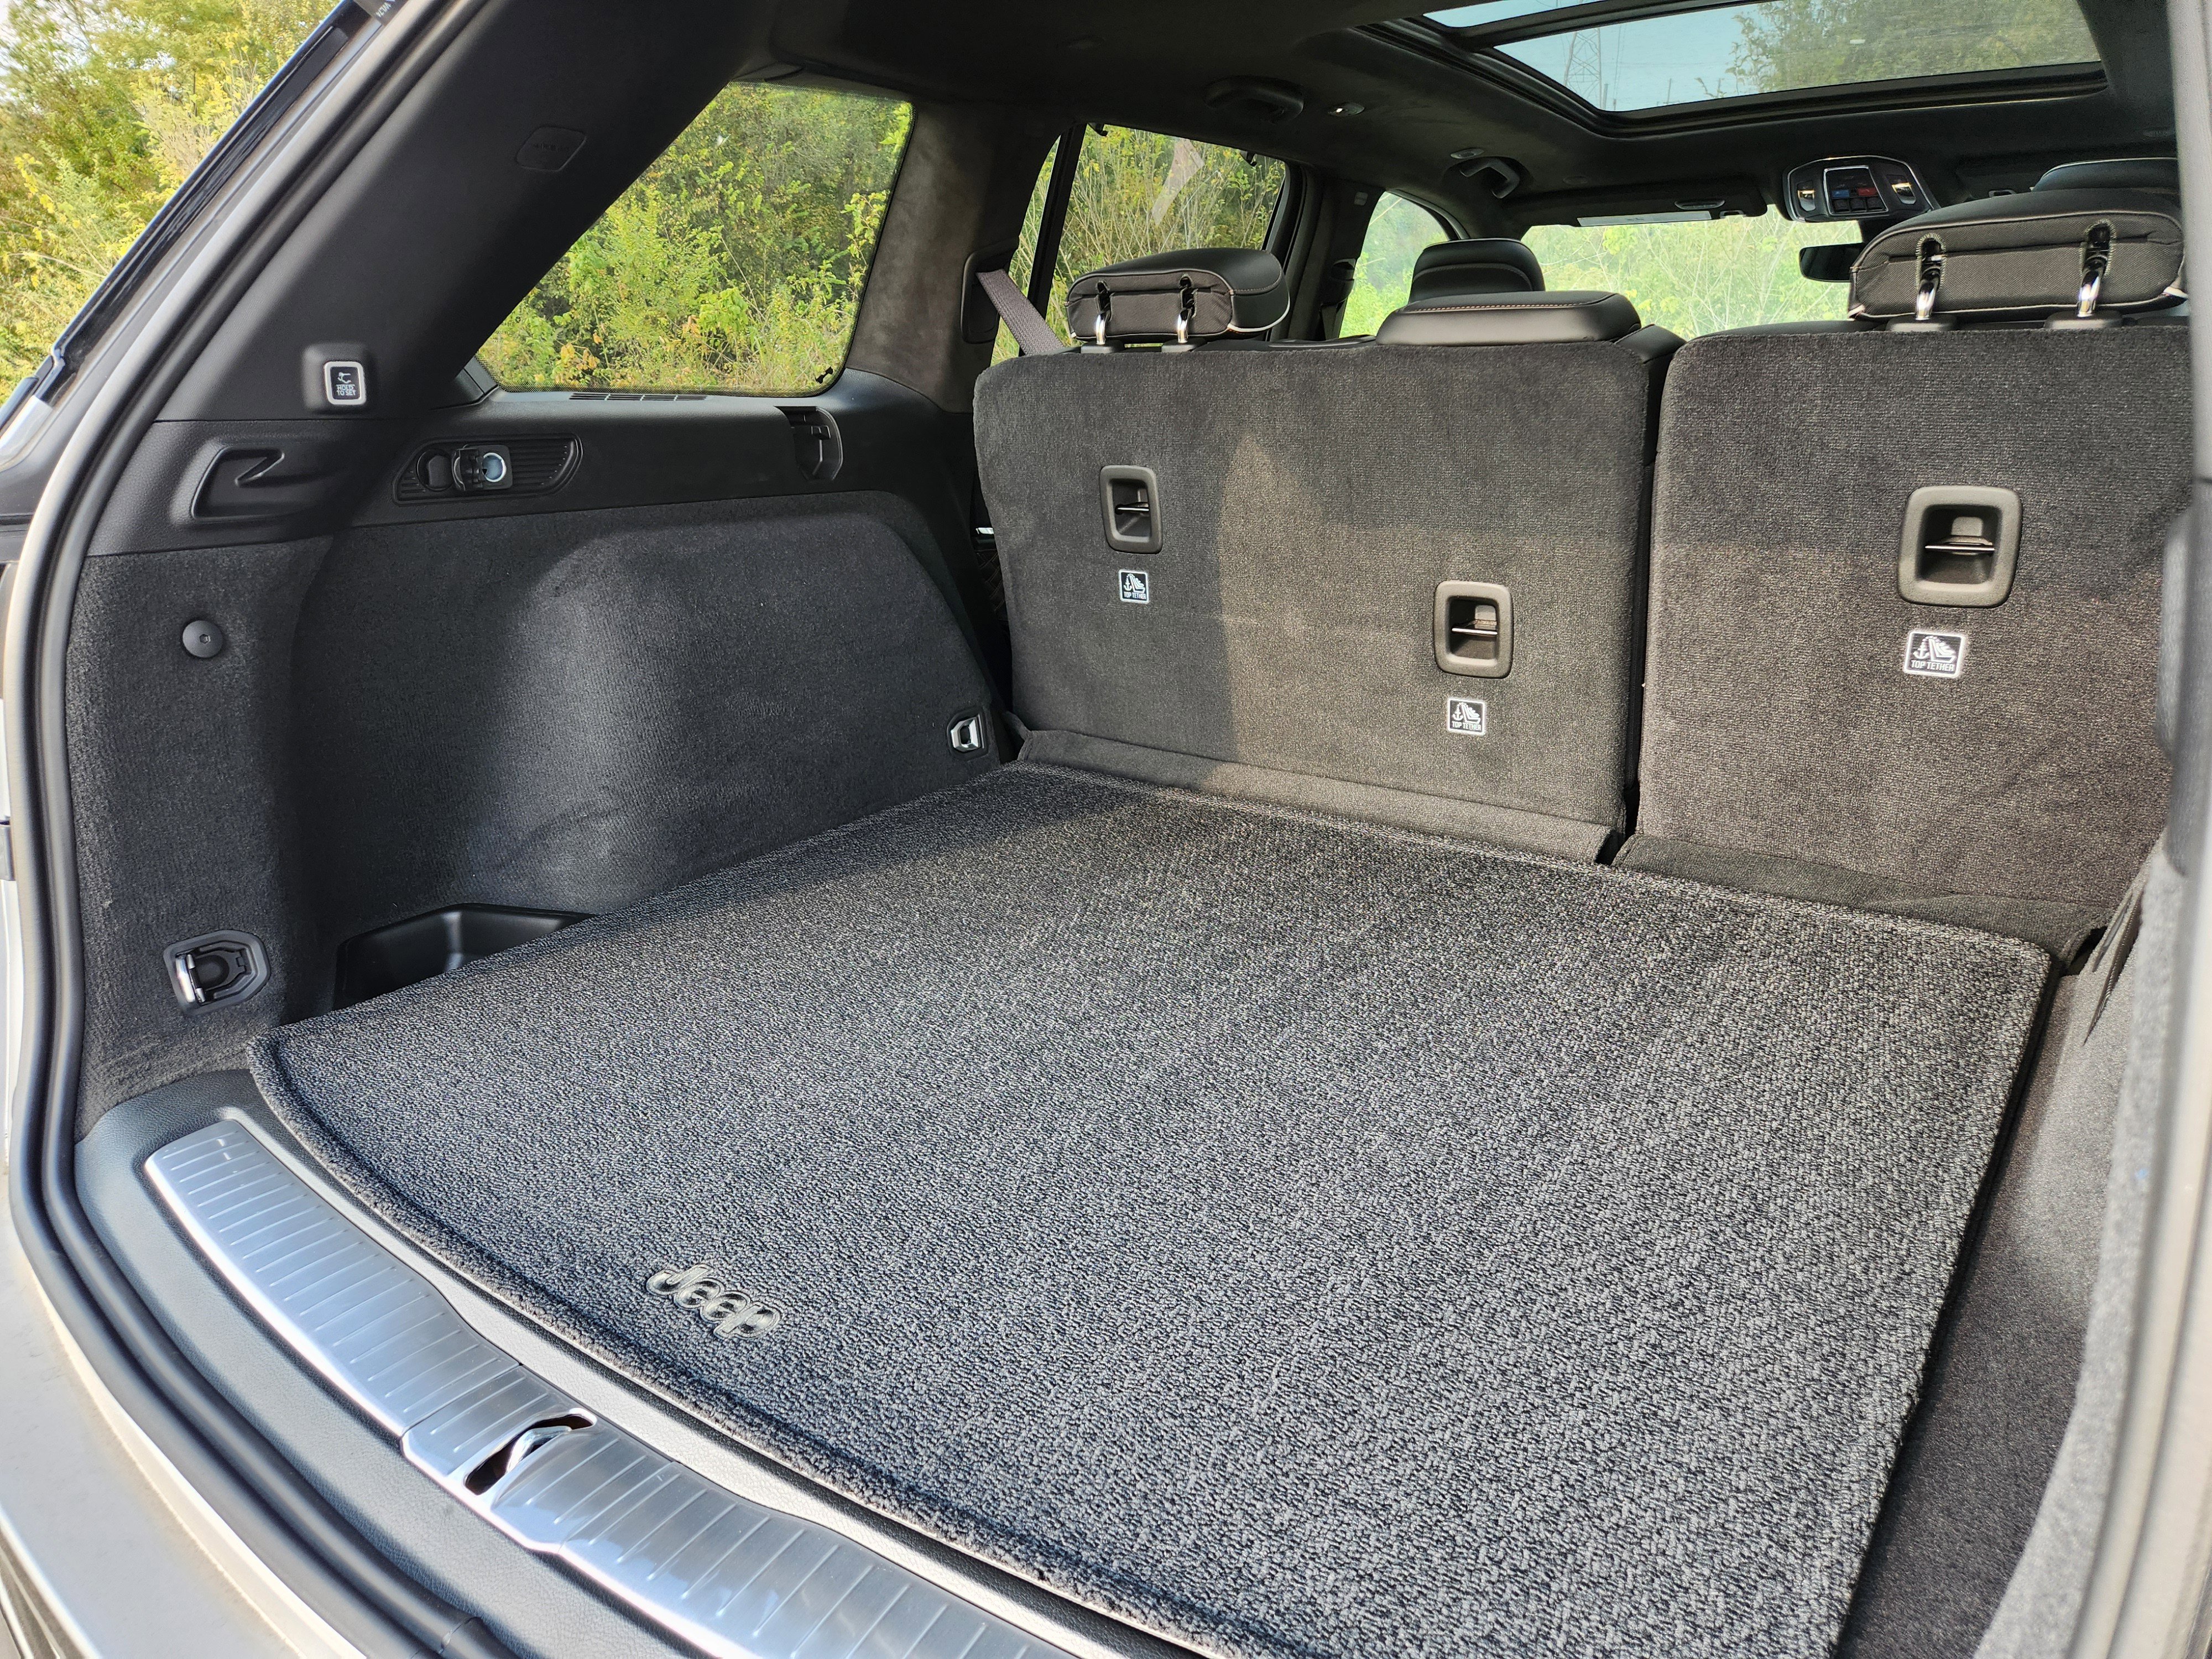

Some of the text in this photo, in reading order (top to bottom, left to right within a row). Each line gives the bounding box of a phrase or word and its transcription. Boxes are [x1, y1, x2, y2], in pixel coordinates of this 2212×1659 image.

[1911, 660, 1955, 671] TOP TETHER
[1463, 722, 1481, 731] TETHER
[646, 1263, 781, 1340] Jeep
